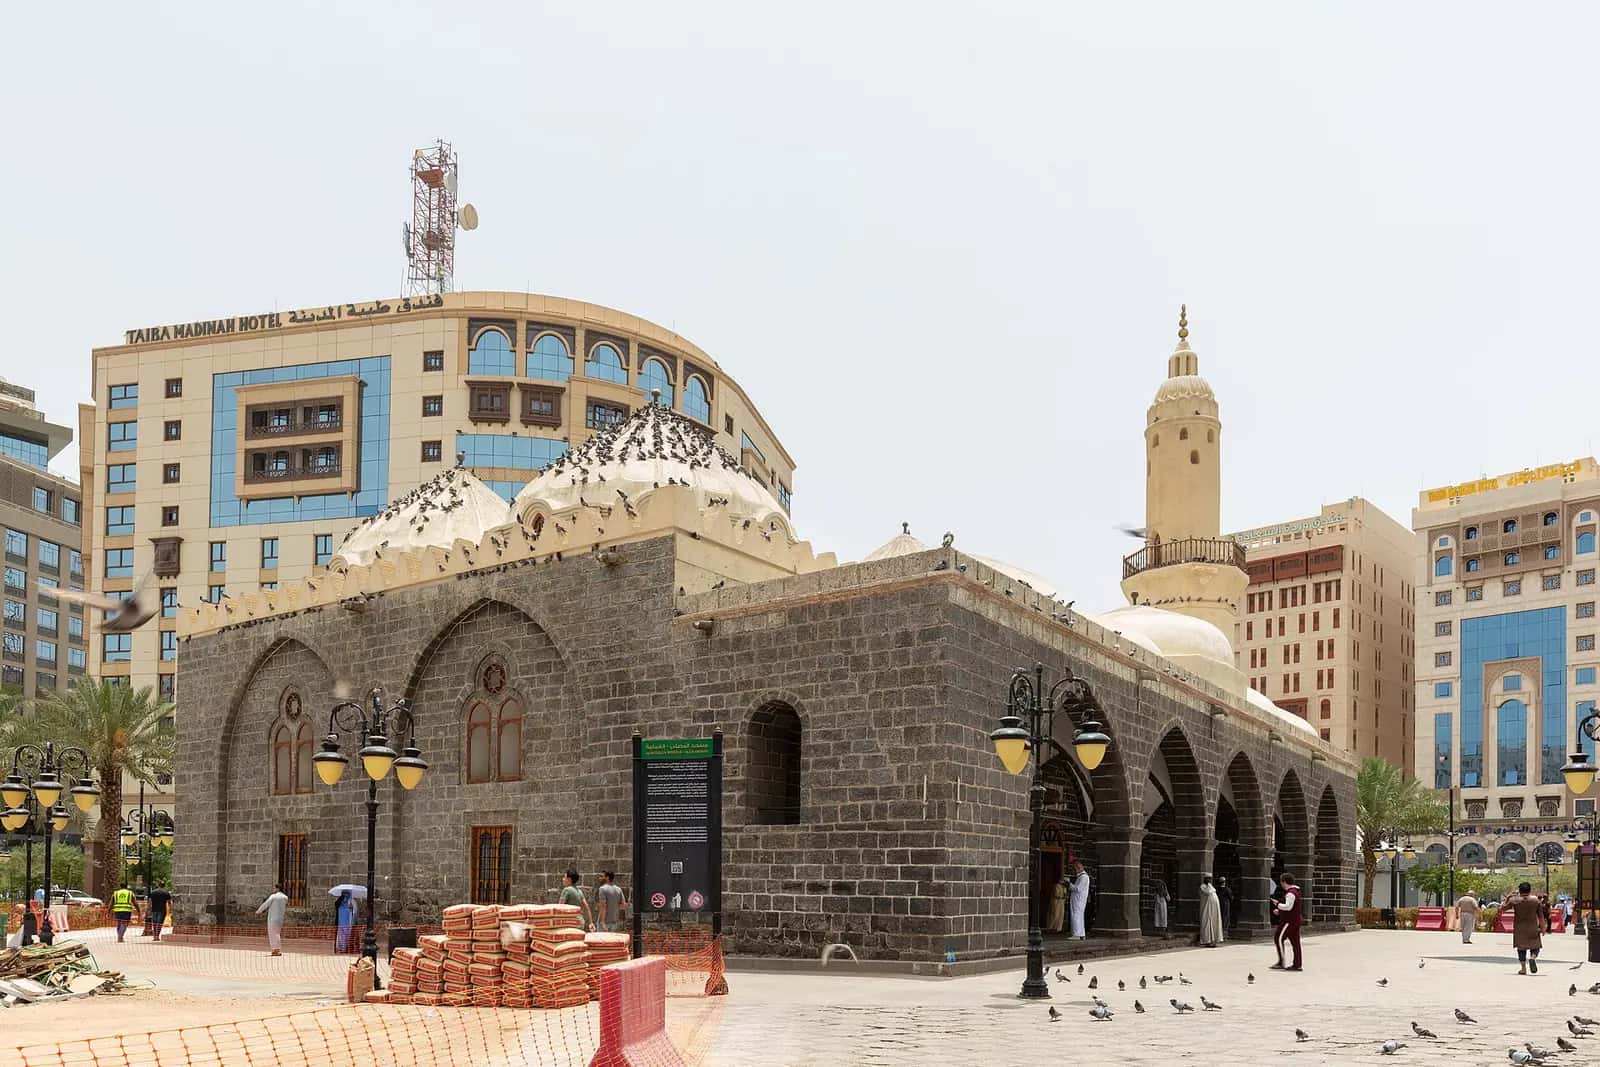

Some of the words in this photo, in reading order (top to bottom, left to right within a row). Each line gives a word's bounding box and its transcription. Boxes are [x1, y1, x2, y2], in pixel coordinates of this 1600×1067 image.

[346, 300, 390, 317] طيبة
[396, 293, 444, 313] فندق
[288, 305, 341, 324] المدينة
[126, 328, 171, 345] TAIBA
[173, 318, 236, 339] MADINAH
[238, 312, 282, 332] HOTEL
